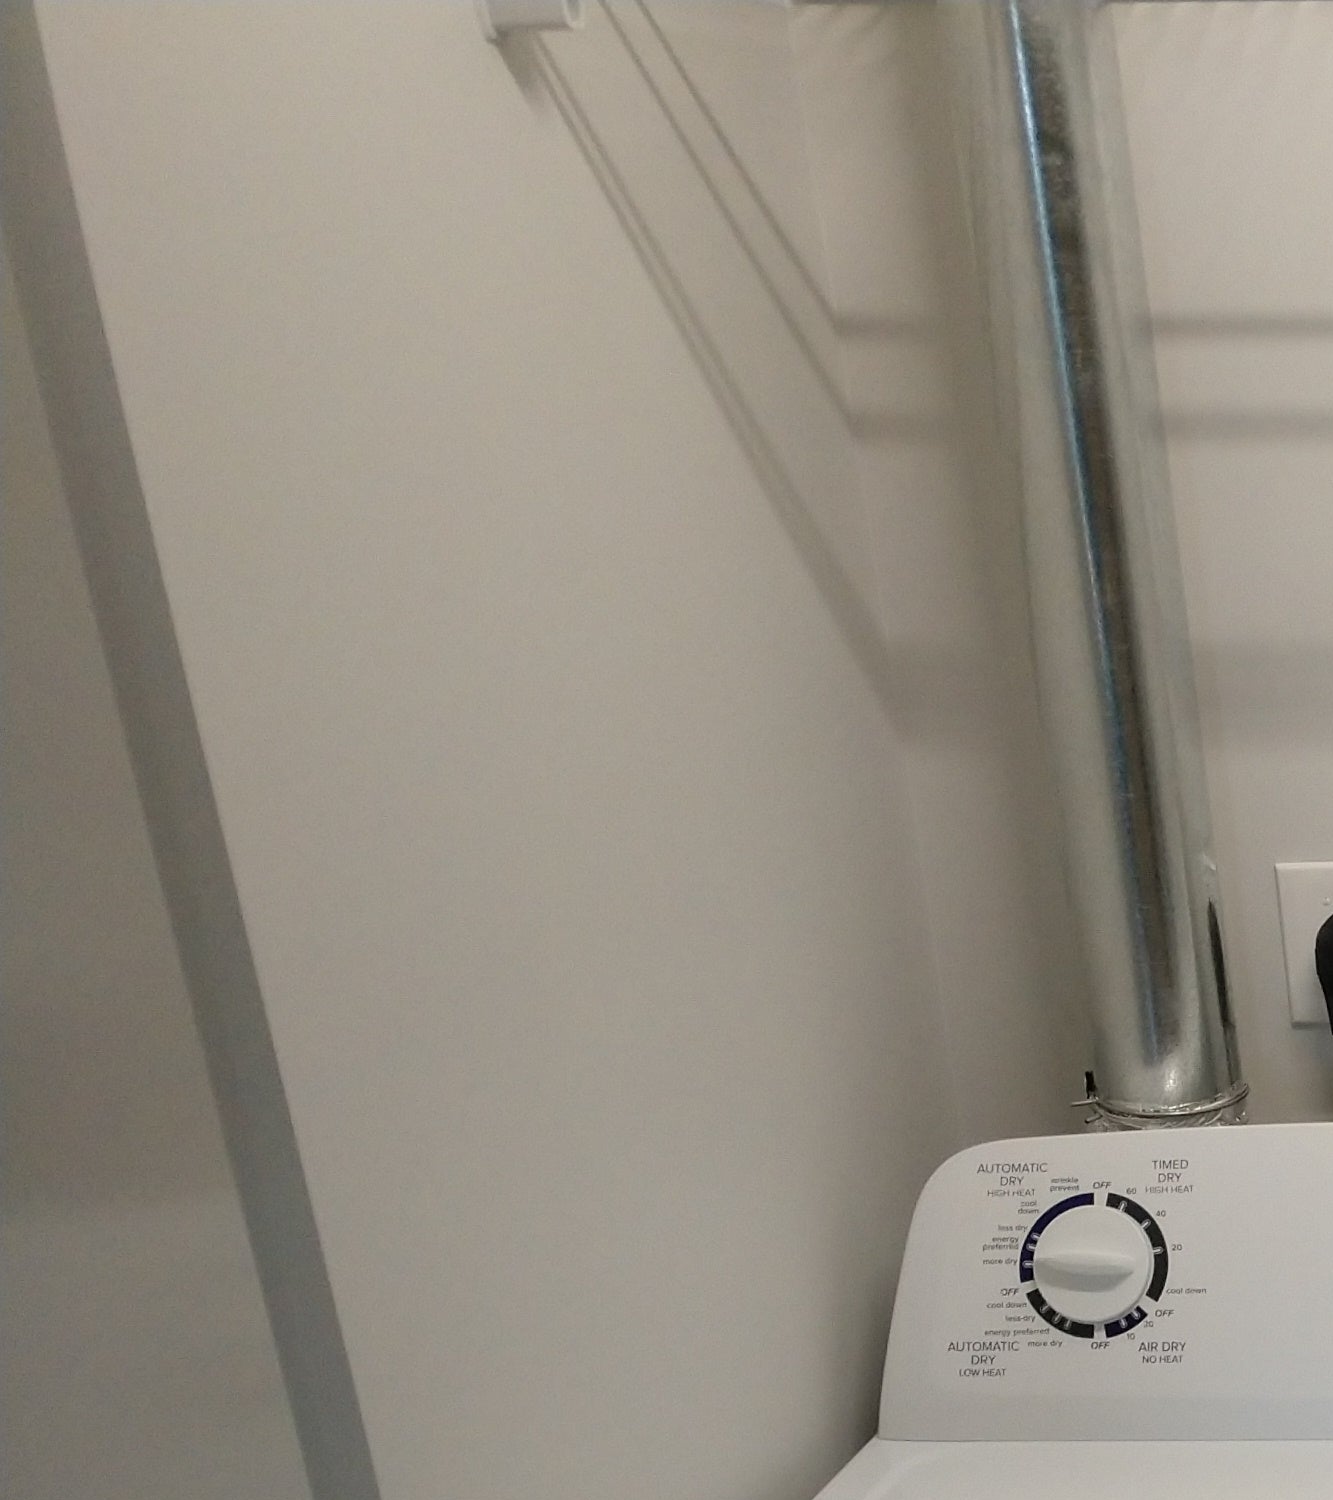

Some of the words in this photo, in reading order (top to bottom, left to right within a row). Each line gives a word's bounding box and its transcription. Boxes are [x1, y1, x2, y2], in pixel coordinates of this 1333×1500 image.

[977, 1162, 1048, 1174] AUTOMATIC
[1152, 1159, 1189, 1170] TIMED
[1000, 1176, 1024, 1187] DRY
[1158, 1172, 1182, 1183] DRY
[1092, 1181, 1112, 1190] OFF
[1171, 1185, 1194, 1194] HEAT
[1012, 1189, 1036, 1197] HEAT
[1126, 1187, 1137, 1195] 60
[1156, 1209, 1167, 1217] 40
[1171, 1243, 1183, 1252] 20
[1005, 1256, 1018, 1266] dry
[1000, 1287, 1020, 1297] OFF
[1155, 1308, 1175, 1318] OFF
[1126, 1332, 1136, 1340] 10
[947, 1340, 1020, 1352] AUTOMATIC
[1090, 1340, 1111, 1350] OFF
[1138, 1341, 1159, 1352] AIR
[1161, 1340, 1186, 1352] DRY
[970, 1354, 997, 1366] DRY
[1142, 1354, 1157, 1364] NO
[1159, 1354, 1183, 1363] HEAT
[958, 1368, 980, 1377] LOW
[982, 1368, 1006, 1377] HEAT
